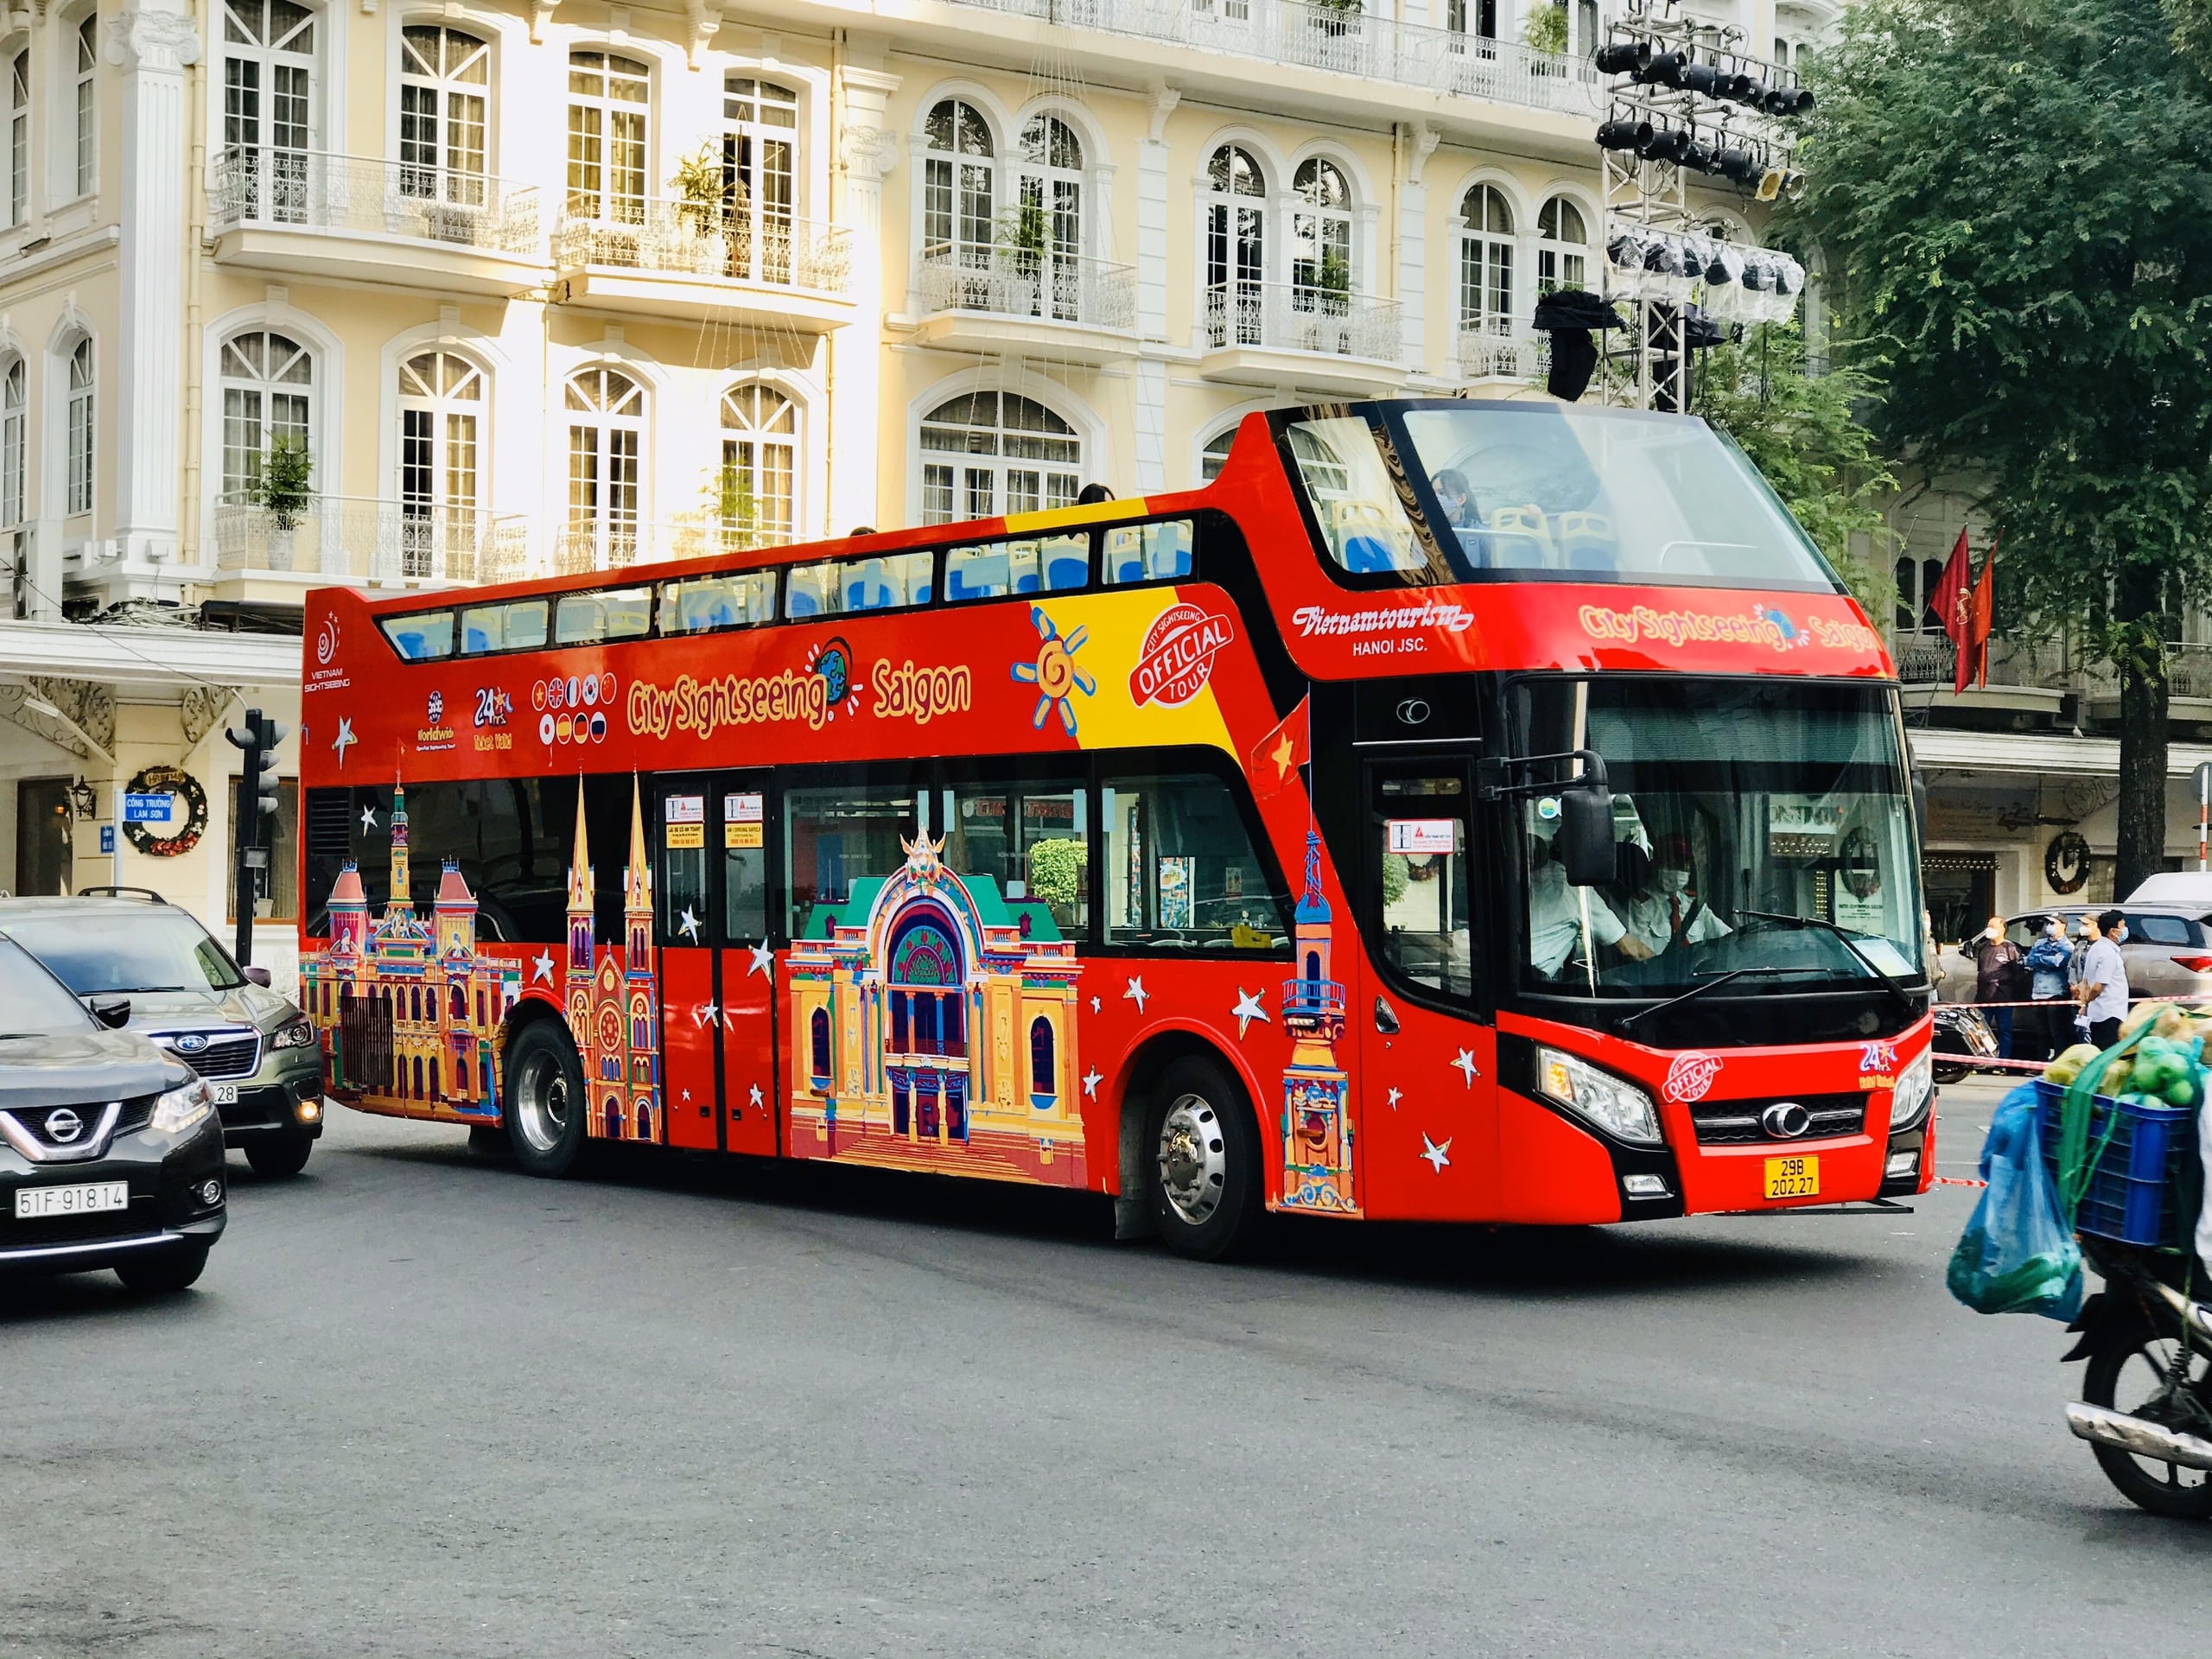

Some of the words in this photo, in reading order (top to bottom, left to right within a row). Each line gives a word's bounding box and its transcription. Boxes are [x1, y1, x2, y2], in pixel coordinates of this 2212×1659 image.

[1147, 630, 1160, 652] CITY
[1158, 610, 1200, 633] SIGHTSEEING
[1292, 599, 1474, 637] Vietnamtourism
[1139, 620, 1227, 695] OFFICIAL
[1352, 639, 1395, 657] HANOI
[1397, 638, 1427, 652] JSC.
[311, 668, 343, 680] VIETNAM
[1169, 663, 1208, 700] TOUR
[872, 658, 971, 725] Saigon
[133, 810, 148, 819] LAM
[1669, 1058, 1719, 1096] OFFICIAL
[1688, 1078, 1710, 1097] TOUR
[1781, 1160, 1803, 1176] 29B
[21, 1186, 124, 1214] 51F-918.14
[1772, 1177, 1814, 1196] 202.27
